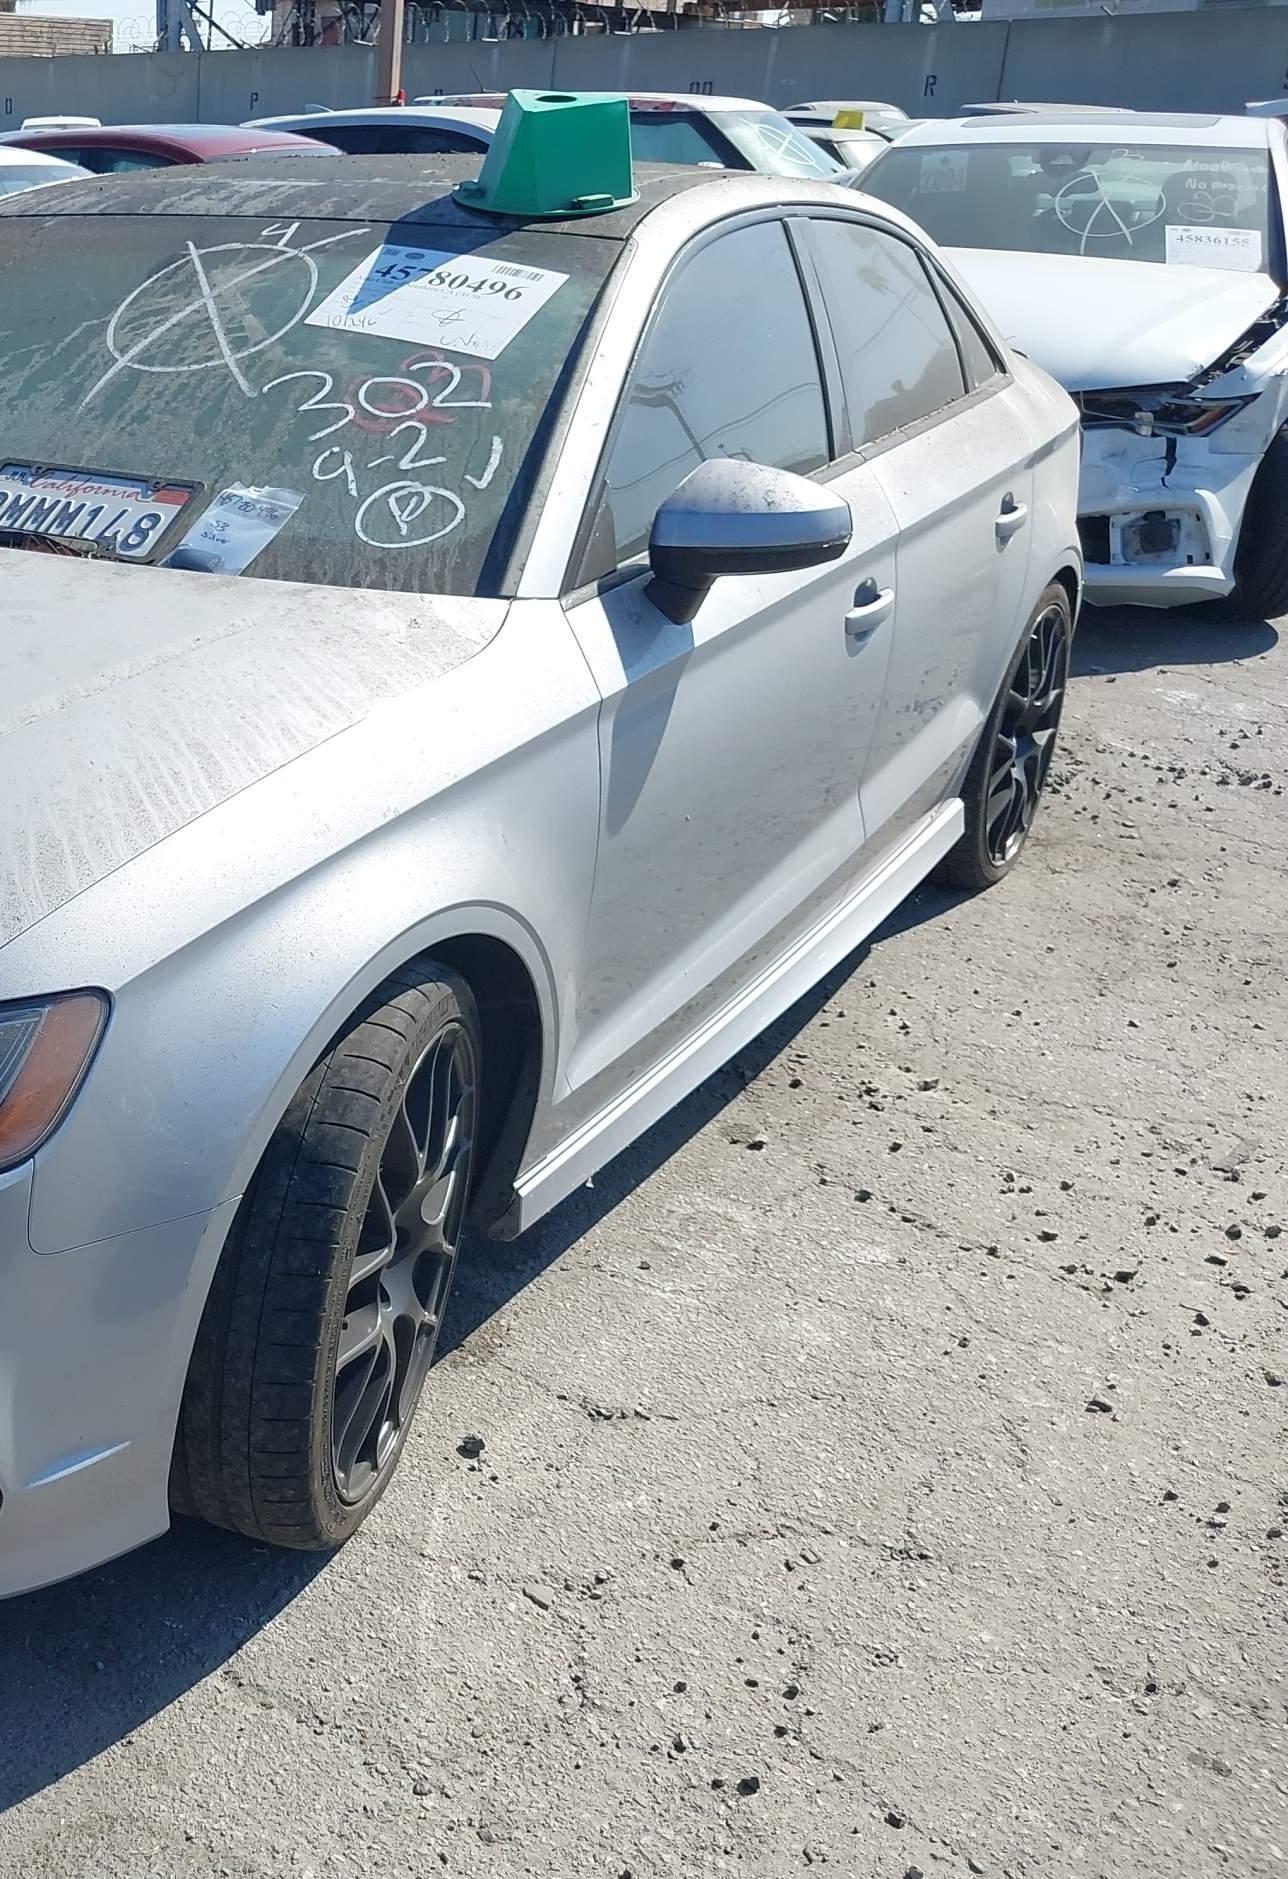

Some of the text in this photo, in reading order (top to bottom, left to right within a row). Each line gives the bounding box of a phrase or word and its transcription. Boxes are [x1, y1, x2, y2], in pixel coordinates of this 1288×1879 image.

[923, 75, 937, 96] R
[250, 92, 258, 110] P
[1176, 234, 1250, 247] 45836155
[375, 264, 530, 301] 45780496
[262, 361, 492, 441] 302
[28, 471, 152, 502] California
